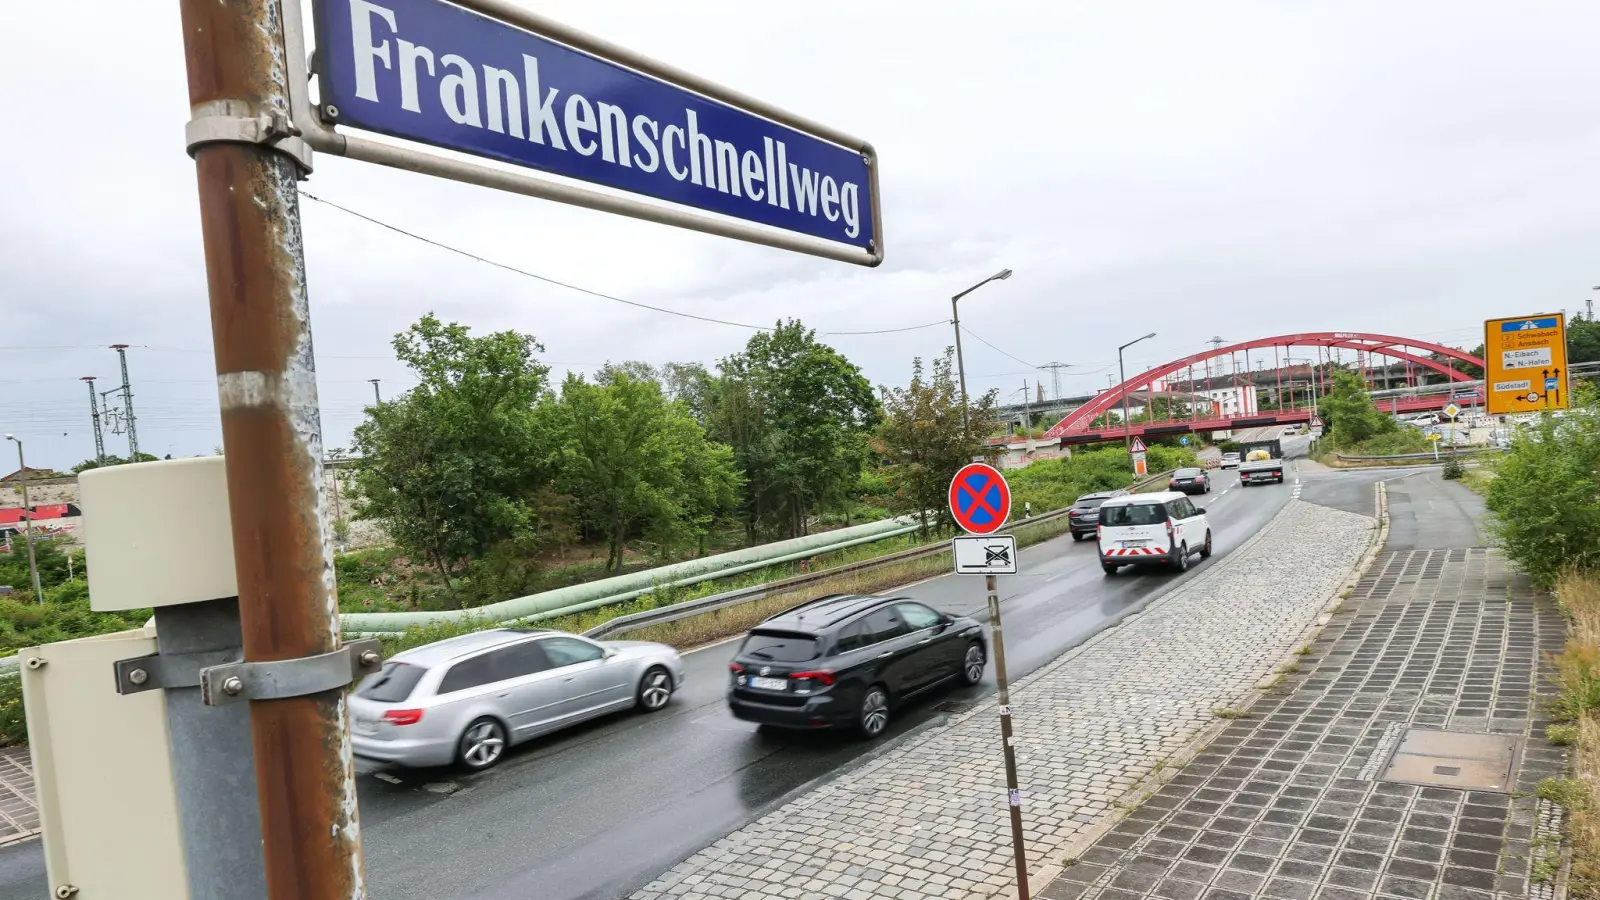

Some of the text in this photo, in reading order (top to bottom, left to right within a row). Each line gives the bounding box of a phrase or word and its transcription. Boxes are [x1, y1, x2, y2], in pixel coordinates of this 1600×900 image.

[349, 0, 860, 239] Frankenschnellweg
[1517, 331, 1558, 340] Schwabach
[1518, 339, 1549, 347] Ansbach
[1496, 382, 1529, 390] Südstadt
